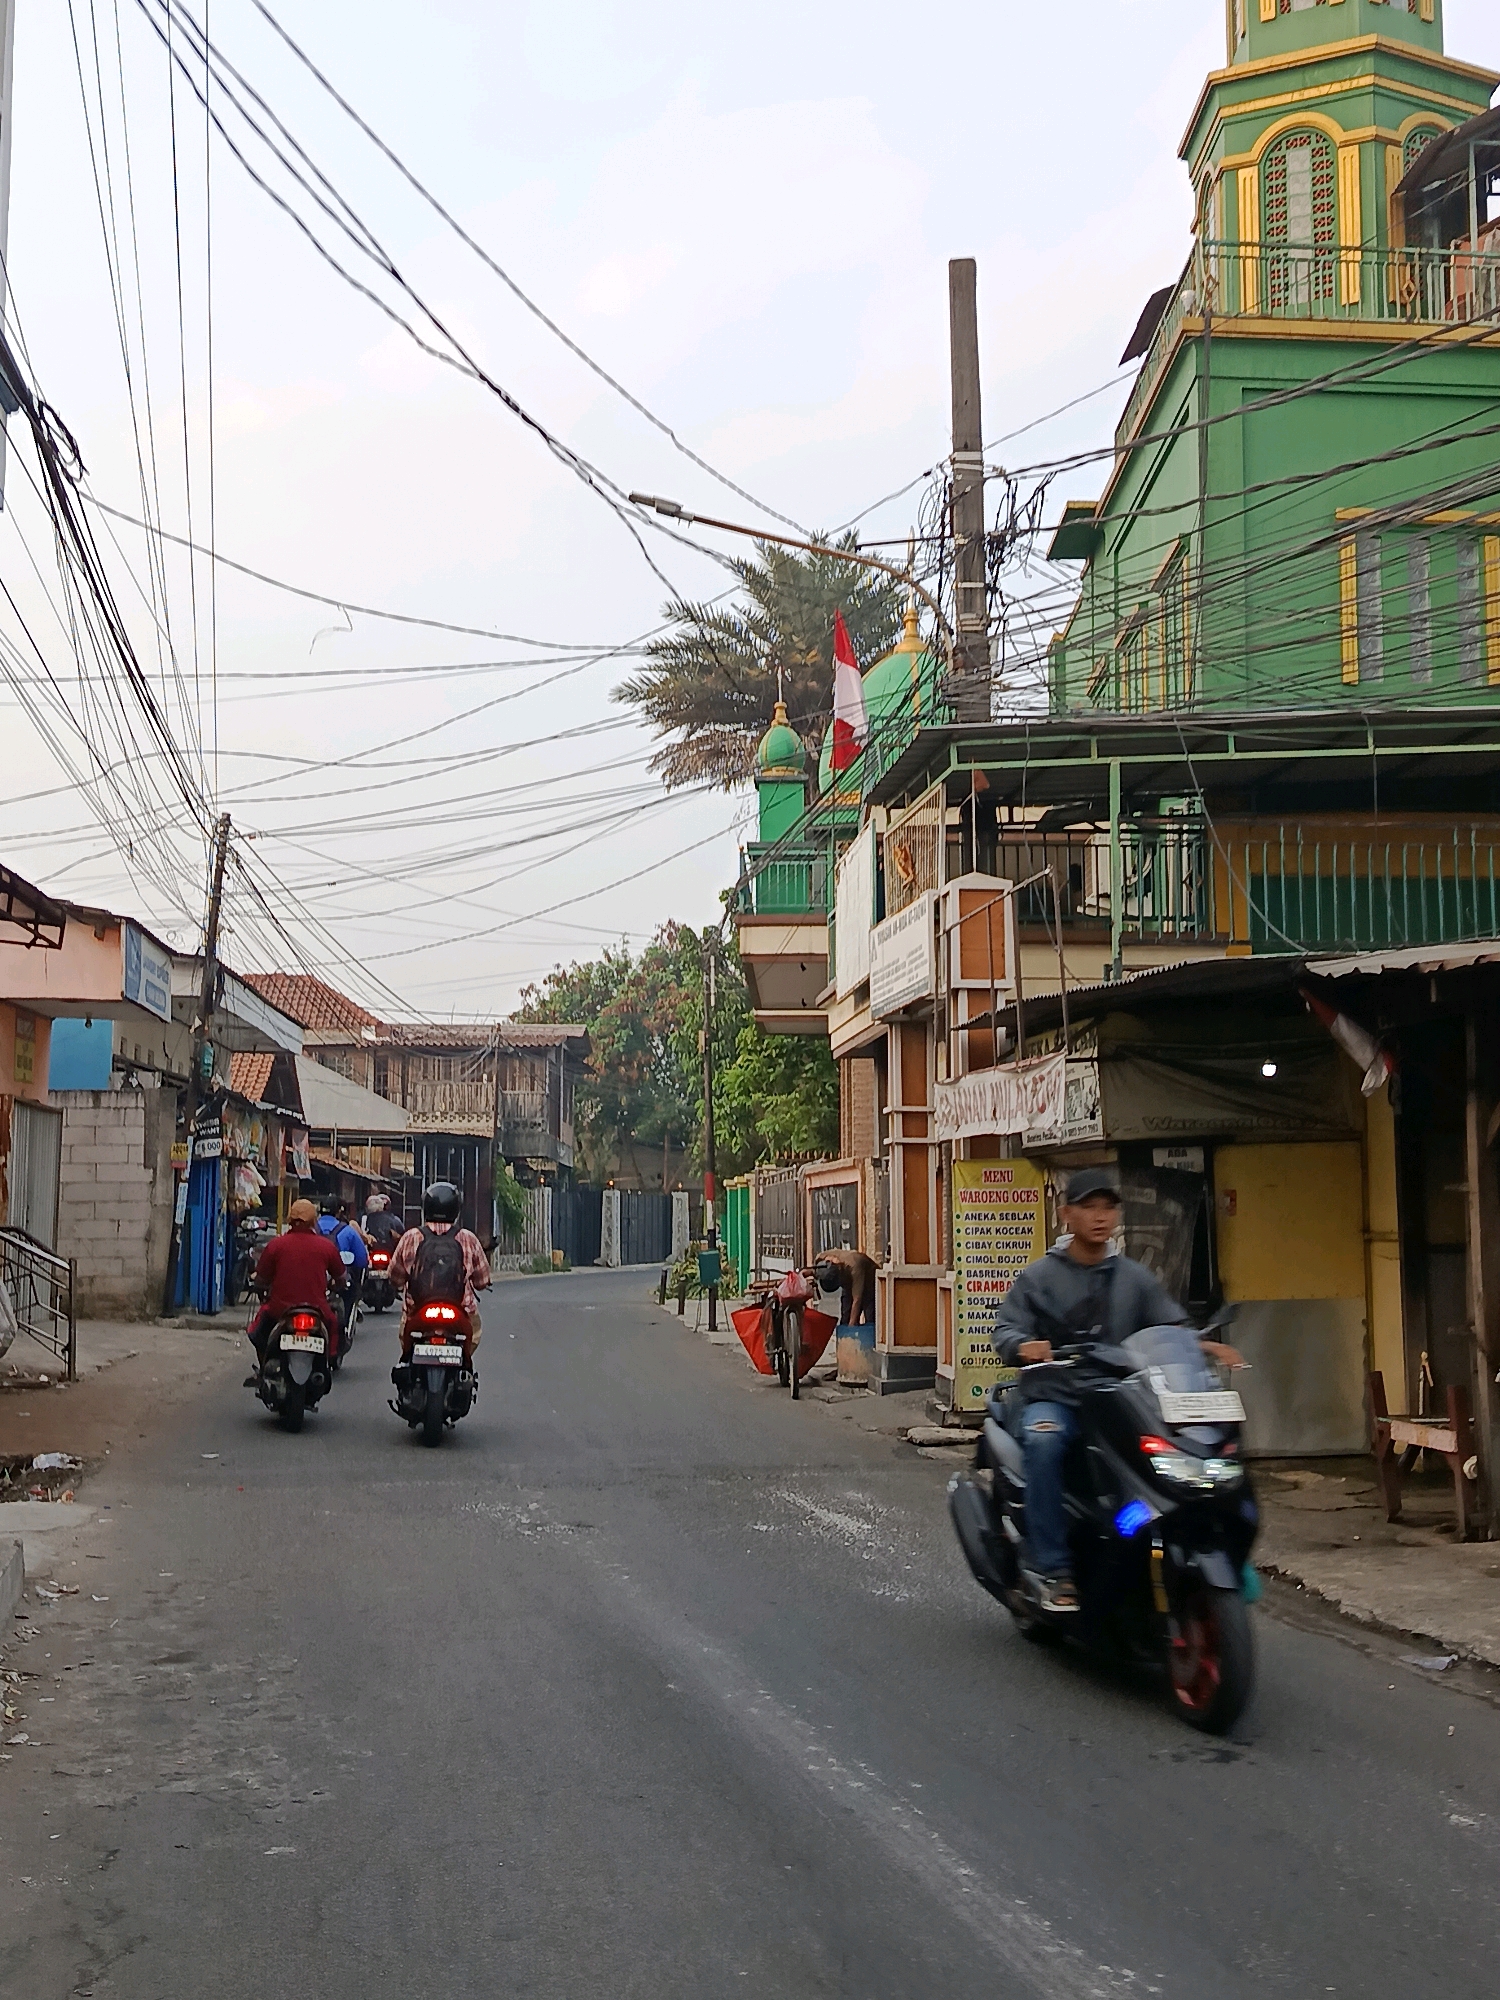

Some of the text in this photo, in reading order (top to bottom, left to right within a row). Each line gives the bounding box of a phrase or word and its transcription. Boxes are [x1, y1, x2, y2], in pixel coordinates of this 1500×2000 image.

[983, 1170, 1013, 1183] MENU
[960, 1190, 1039, 1203] WAROENG OCES
[964, 1212, 1036, 1221] ANEKA SEBLAK
[965, 1227, 1034, 1235] CIPAK KOCEAK
[965, 1241, 1031, 1250] CIBAY CIKRUH
[965, 1255, 1028, 1264] CIMOL BOJOT
[966, 1269, 1010, 1278] BASRENG
[966, 1280, 1014, 1292] CIRAMBA
[970, 1344, 992, 1352] BISA
